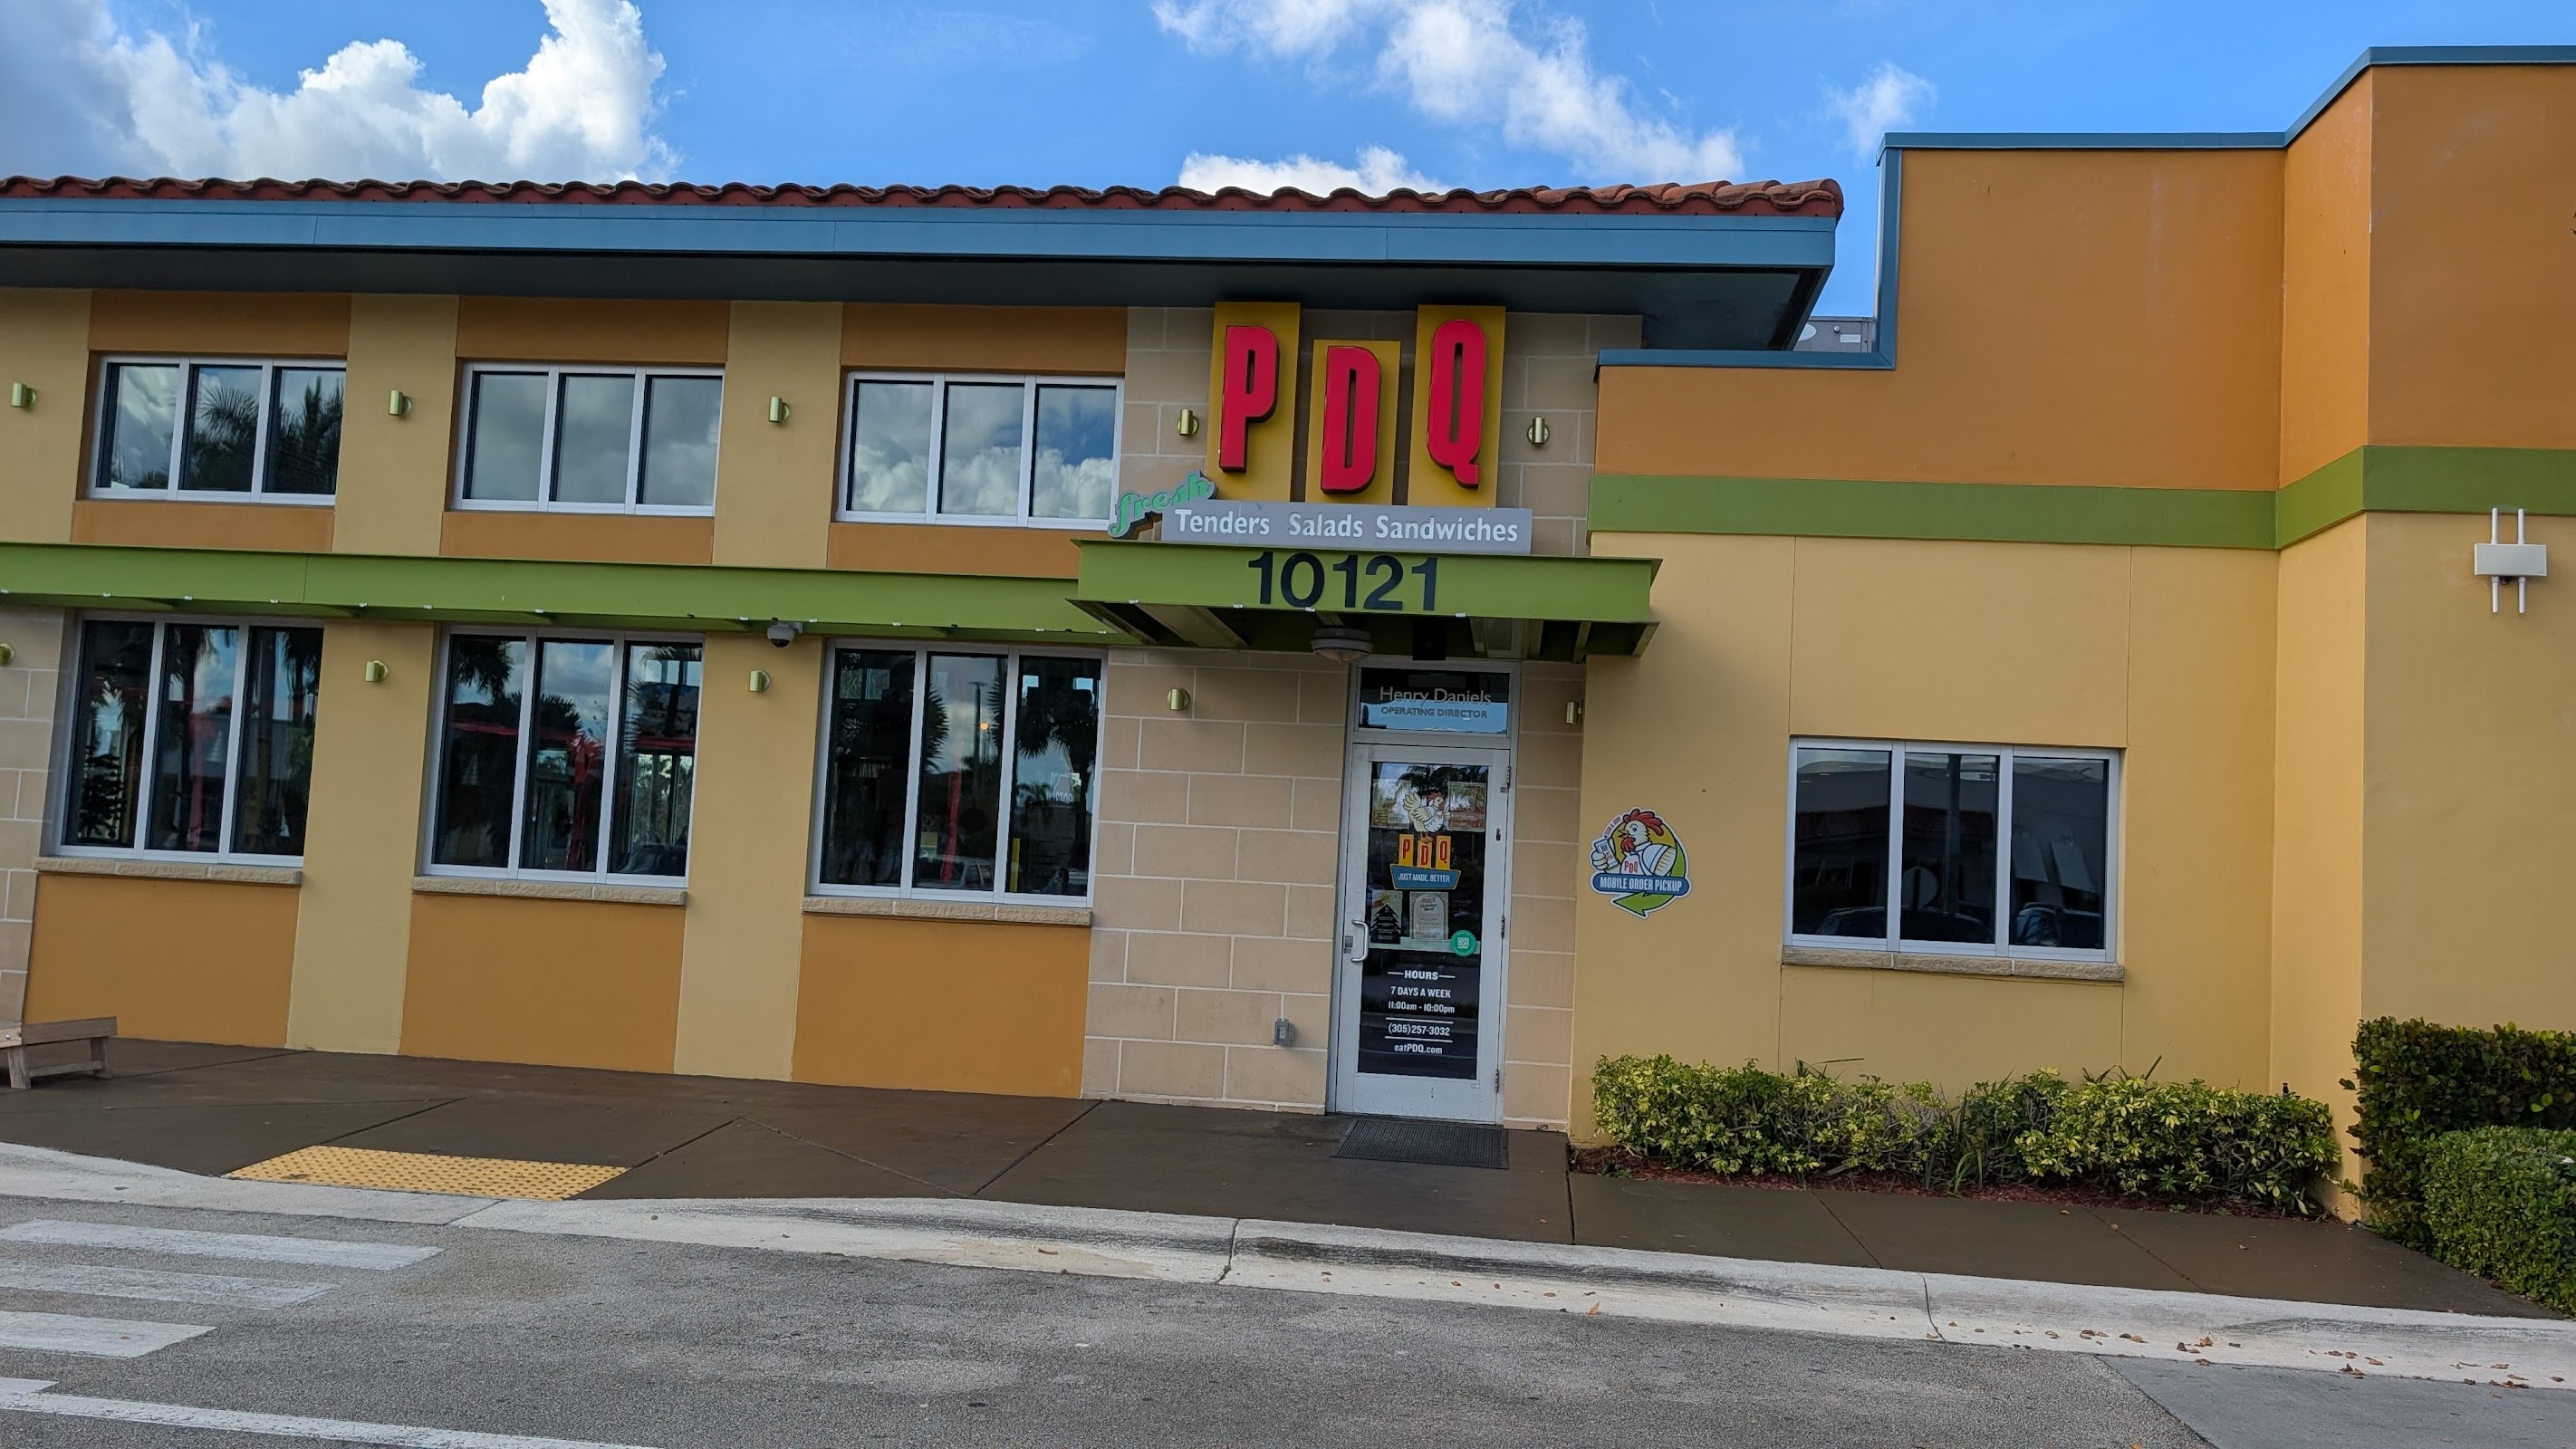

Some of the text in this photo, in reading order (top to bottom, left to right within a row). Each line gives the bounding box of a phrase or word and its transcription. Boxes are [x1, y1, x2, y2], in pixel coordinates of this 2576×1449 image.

[1218, 319, 1487, 494] PDQ
[1110, 472, 1212, 536] fresh
[1175, 508, 1519, 542] Tenders Salads Sandwiches
[1247, 551, 1438, 611] 10121
[1379, 686, 1492, 706] Henry Daniels
[1380, 706, 1488, 718] OPERATING DIRECTOR
[1402, 839, 1447, 866] PDQ
[1624, 860, 1639, 874] PDQ
[1398, 872, 1412, 881] JUST
[1429, 874, 1450, 883] BETTER
[1600, 876, 1683, 892] MOBILE ORDER PICKUP
[1404, 970, 1438, 980] HOURS
[1390, 986, 1451, 998] 7 DAYS A WEEK
[1388, 1001, 1417, 1011] 11:00am
[1423, 1003, 1455, 1014] 10:00pm
[1388, 1022, 1450, 1036] (305)257-3032
[1394, 1042, 1443, 1055] eatPDQ.com
